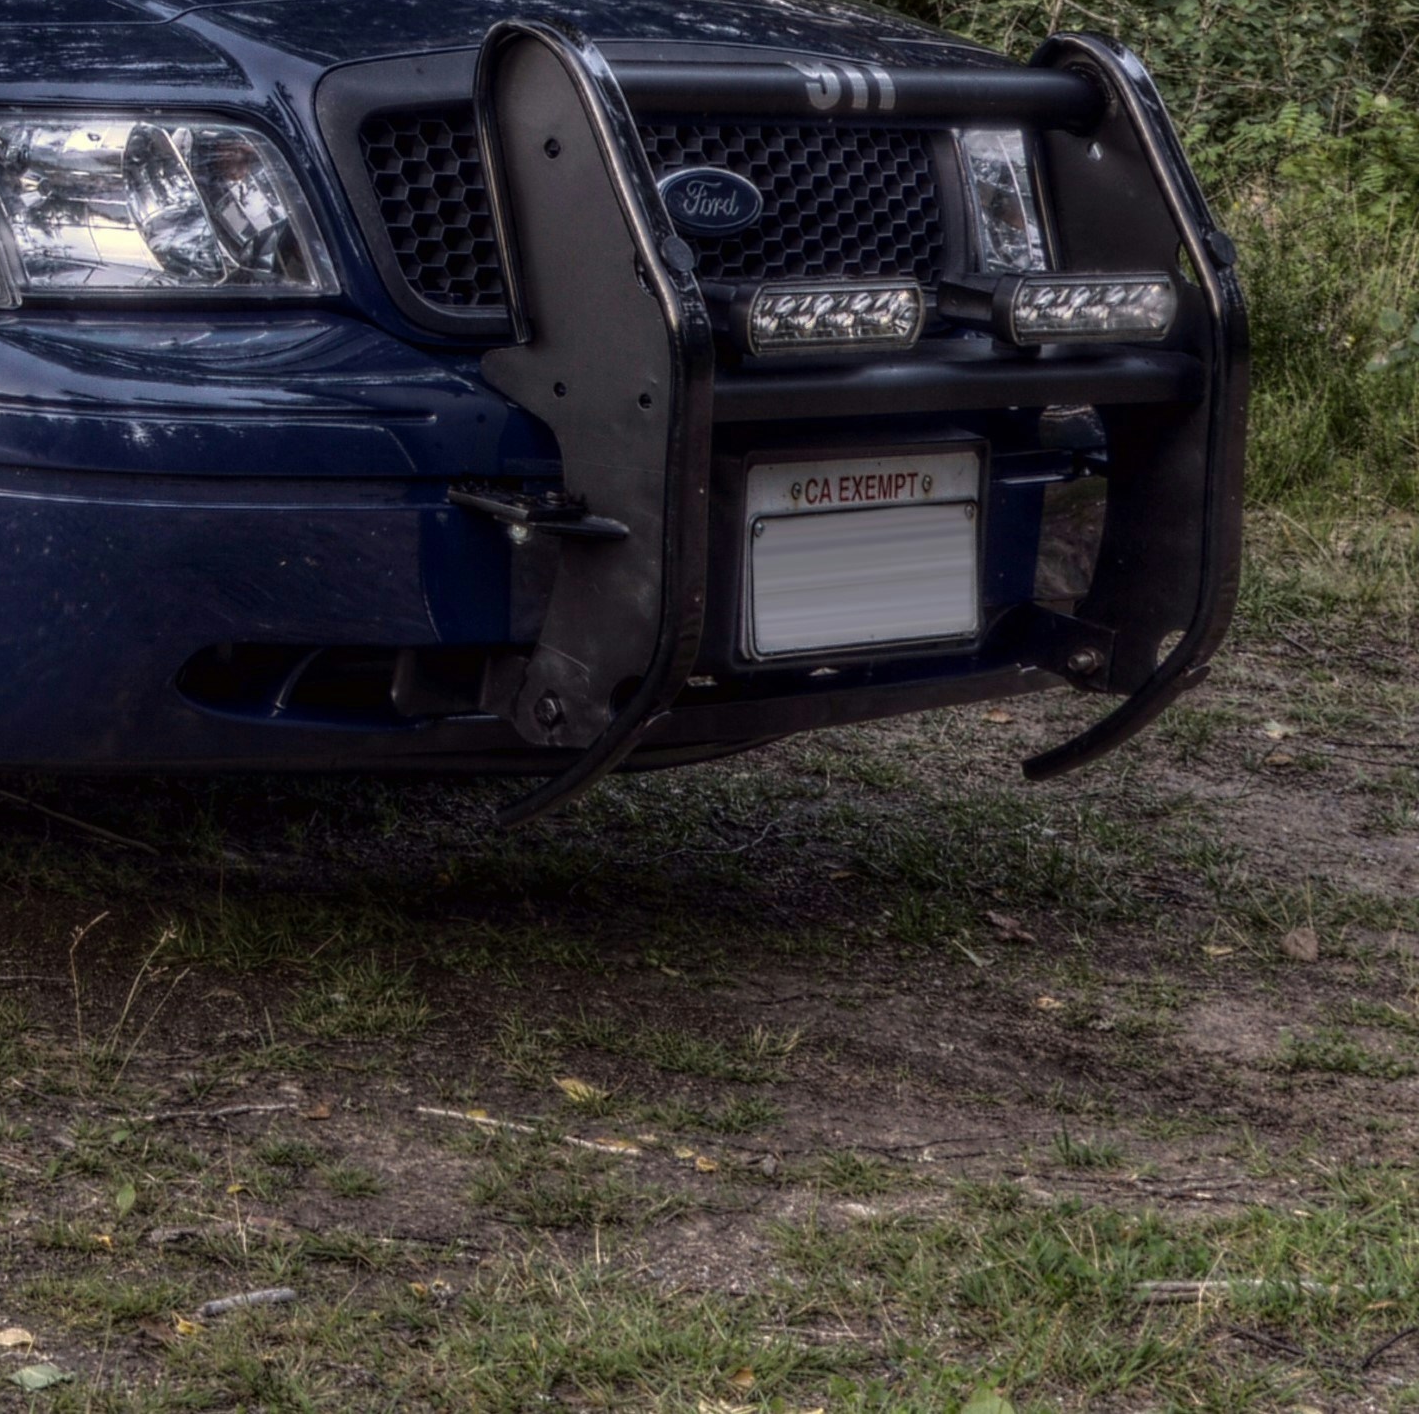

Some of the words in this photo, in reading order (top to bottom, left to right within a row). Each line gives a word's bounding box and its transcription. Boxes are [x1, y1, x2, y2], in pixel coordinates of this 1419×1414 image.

[683, 180, 739, 216] Ford
[804, 478, 832, 504] CA
[839, 472, 919, 502] EXEMPT
